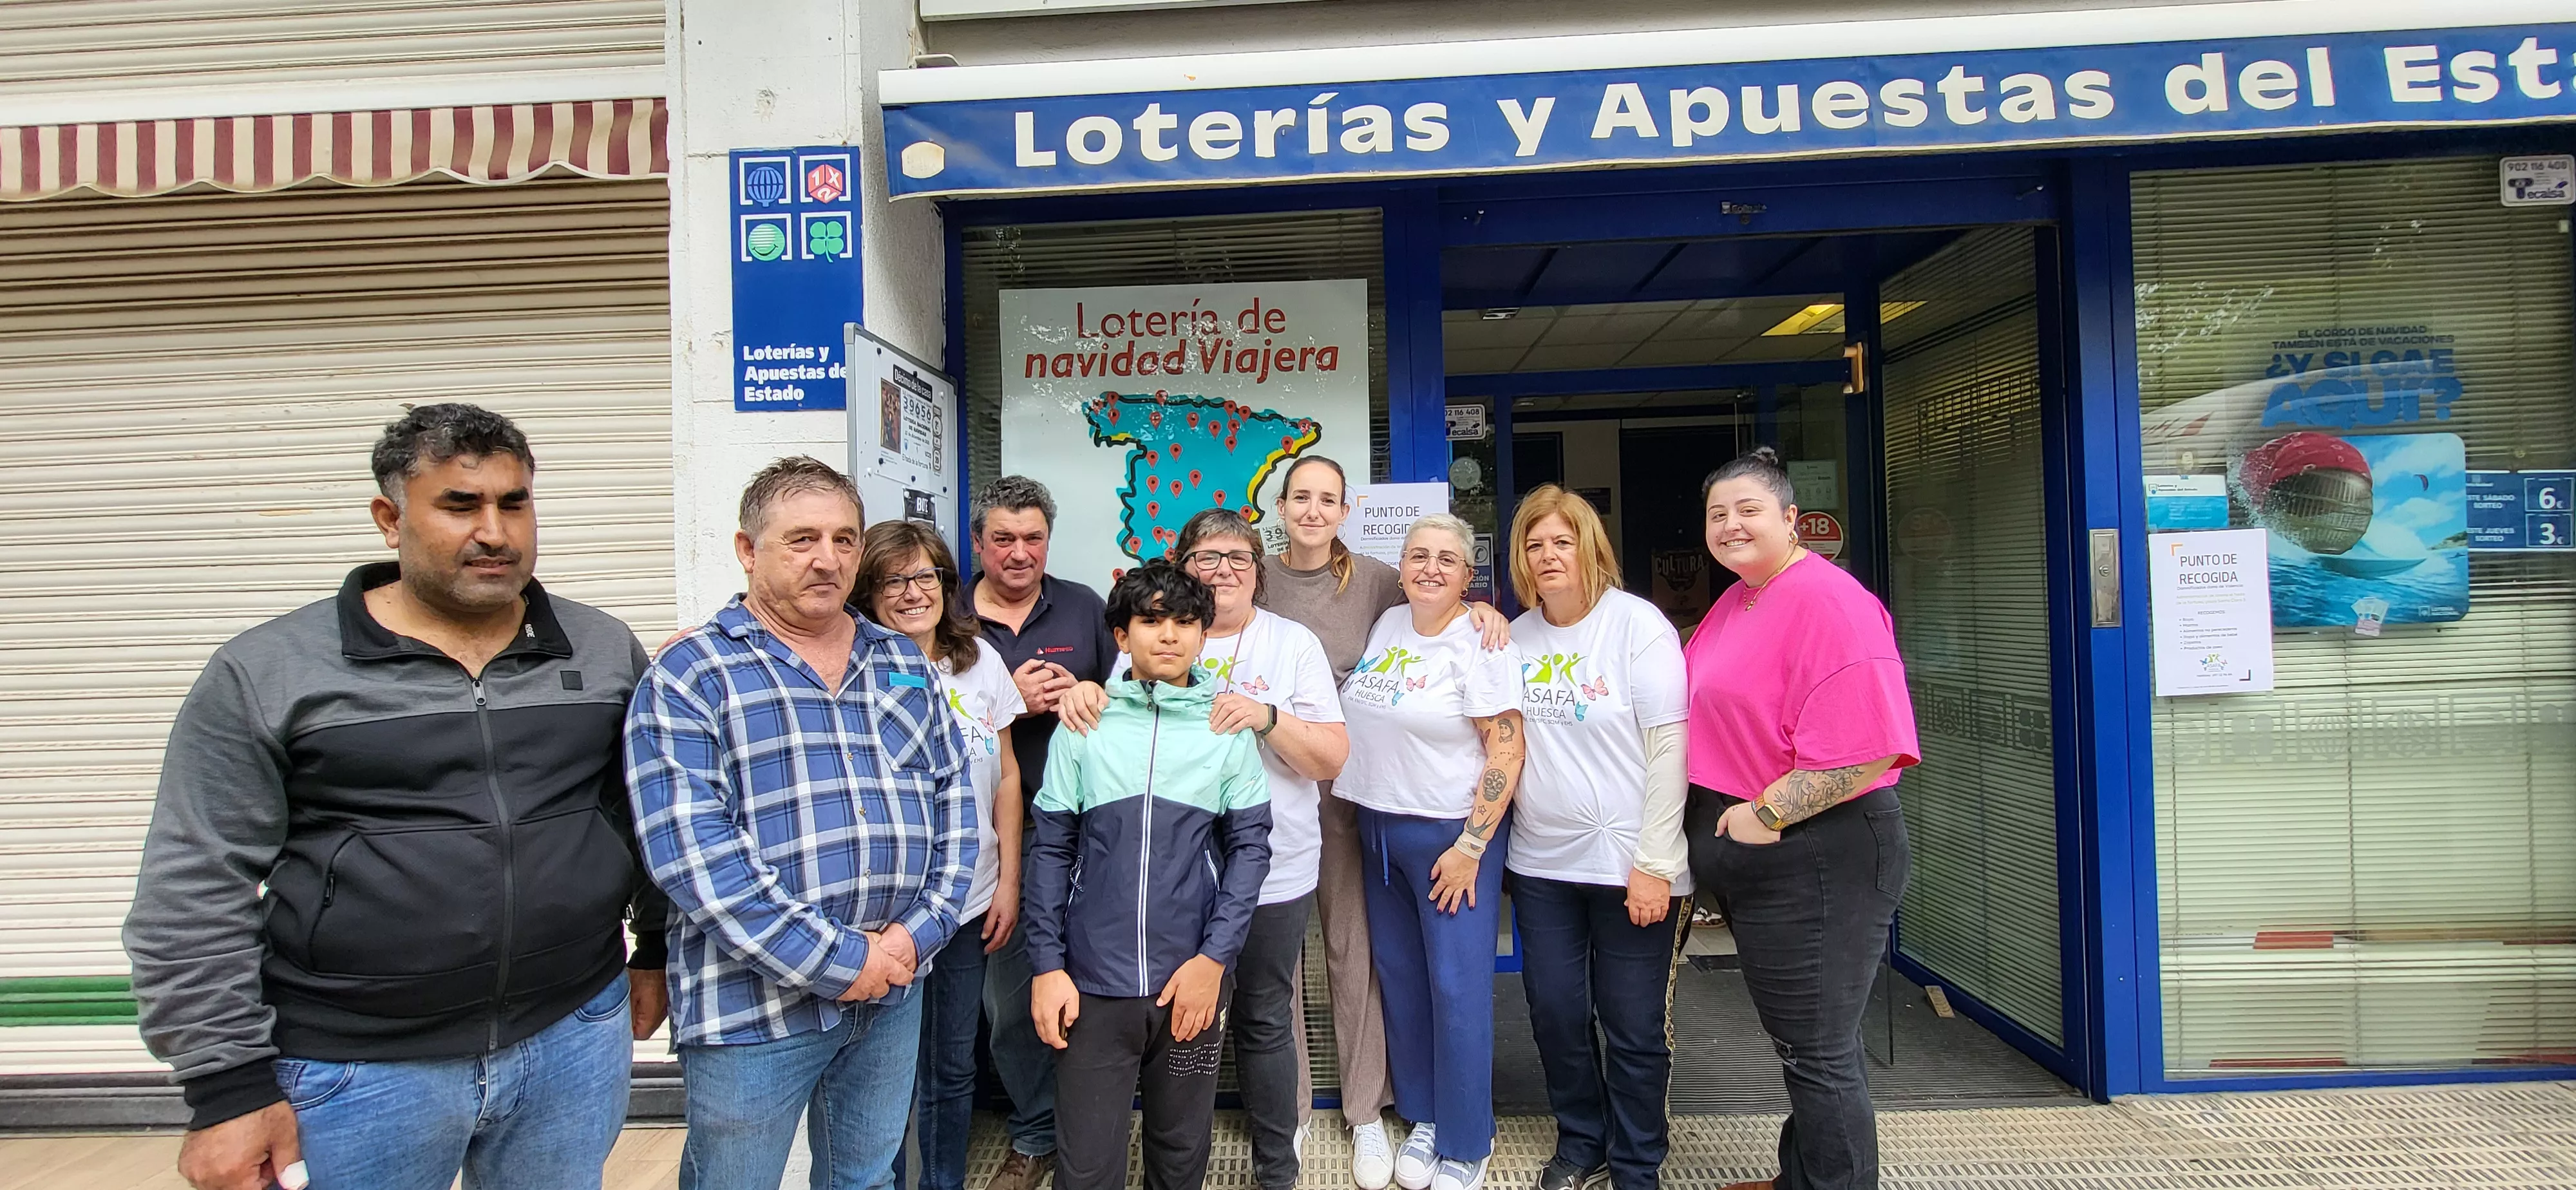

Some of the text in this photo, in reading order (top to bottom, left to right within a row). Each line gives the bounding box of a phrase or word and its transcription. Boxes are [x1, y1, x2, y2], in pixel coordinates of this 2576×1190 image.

[1015, 36, 2576, 167] Loterías y Apuestas del Est
[1077, 298, 1286, 339] Lotería de
[2298, 326, 2426, 338] EL GORDO DE NAVIDAD
[2360, 337, 2375, 346] DE
[2378, 335, 2454, 346] VACACIONES
[743, 344, 829, 362] Loterías y
[1025, 339, 1338, 383] navidad Viajera
[2324, 350, 2360, 376] SI
[2371, 349, 2454, 376] CAE
[744, 363, 847, 385] Apuestas de
[744, 384, 804, 402] Estado
[904, 396, 931, 420] 39656
[1365, 506, 1419, 518] PUNTO DE
[1799, 518, 1829, 534] +18
[1656, 554, 1705, 575] CULTURA
[2180, 554, 2237, 567] PUNTO DE
[2179, 571, 2238, 584] RECOGIDA
[1354, 674, 1399, 693] ASAFA
[1355, 689, 1385, 703] HUESCA
[1523, 687, 1575, 706] ASAFA
[1527, 706, 1566, 719] HUESCA
